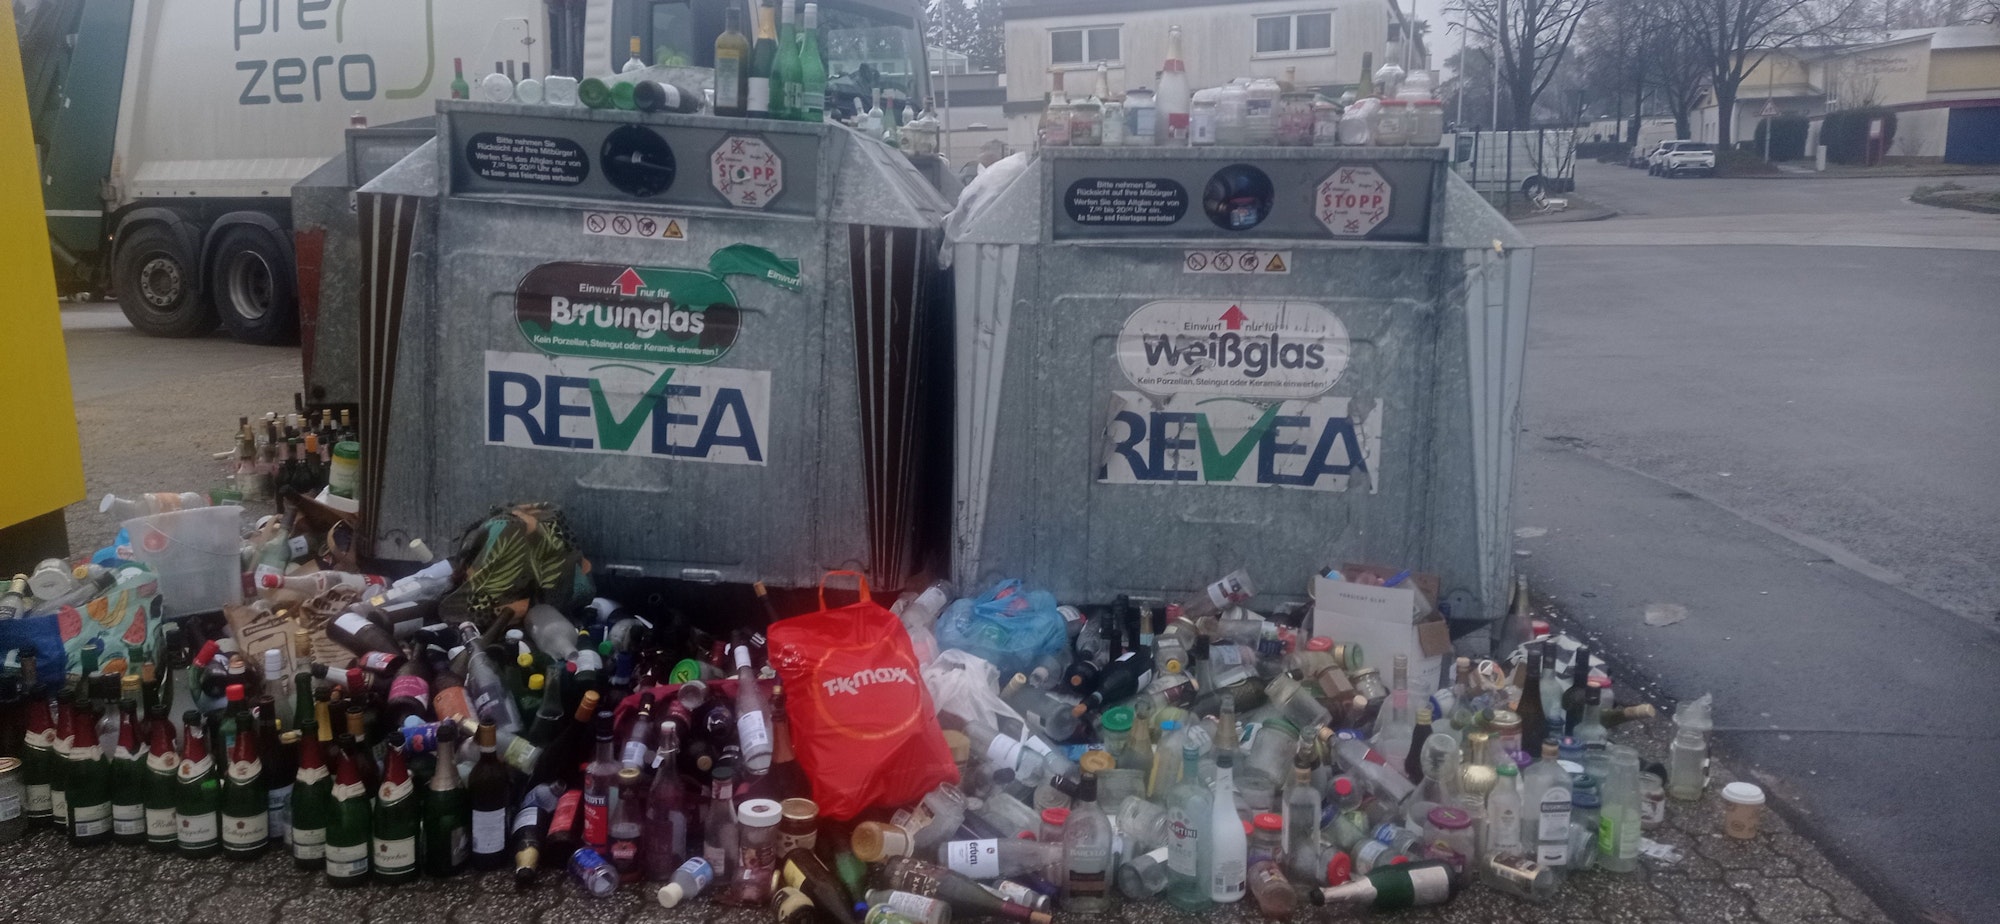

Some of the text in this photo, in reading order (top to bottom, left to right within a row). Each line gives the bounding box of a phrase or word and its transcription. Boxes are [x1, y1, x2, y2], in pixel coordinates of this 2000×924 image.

[235, 54, 377, 105] zero
[477, 143, 511, 152] Rücksicht
[512, 145, 524, 153] auf
[525, 146, 538, 154] Ihre
[496, 136, 556, 148] Bitte nehmen Sie
[475, 152, 501, 161] Werfen
[501, 154, 513, 162] Sie
[515, 155, 527, 163] das
[529, 156, 553, 165] Altglas
[568, 160, 581, 168] von
[1077, 188, 1110, 196] Rücksicht
[1112, 188, 1123, 196] auf
[1097, 181, 1157, 189] Bitte nehmen Sie
[1074, 198, 1098, 206] Werfen
[1100, 198, 1111, 206] Sie
[1113, 198, 1126, 206] das
[1128, 198, 1152, 207] Altglas
[1323, 194, 1383, 209] STOPP
[767, 269, 800, 286] Einwurf
[579, 283, 670, 298] Einwurf nur für
[1184, 322, 1221, 331] Einwurf
[533, 335, 551, 344] Kein
[552, 336, 589, 348] Porzellan,
[590, 339, 623, 350] Steingut
[624, 342, 641, 350] oder
[644, 343, 676, 353] Keramik
[1143, 332, 1325, 378] Weißglas
[1196, 378, 1228, 388] Steingut
[1250, 379, 1281, 387] Keramik
[488, 368, 763, 462] REVEA
[1098, 402, 1368, 486] REVEA
